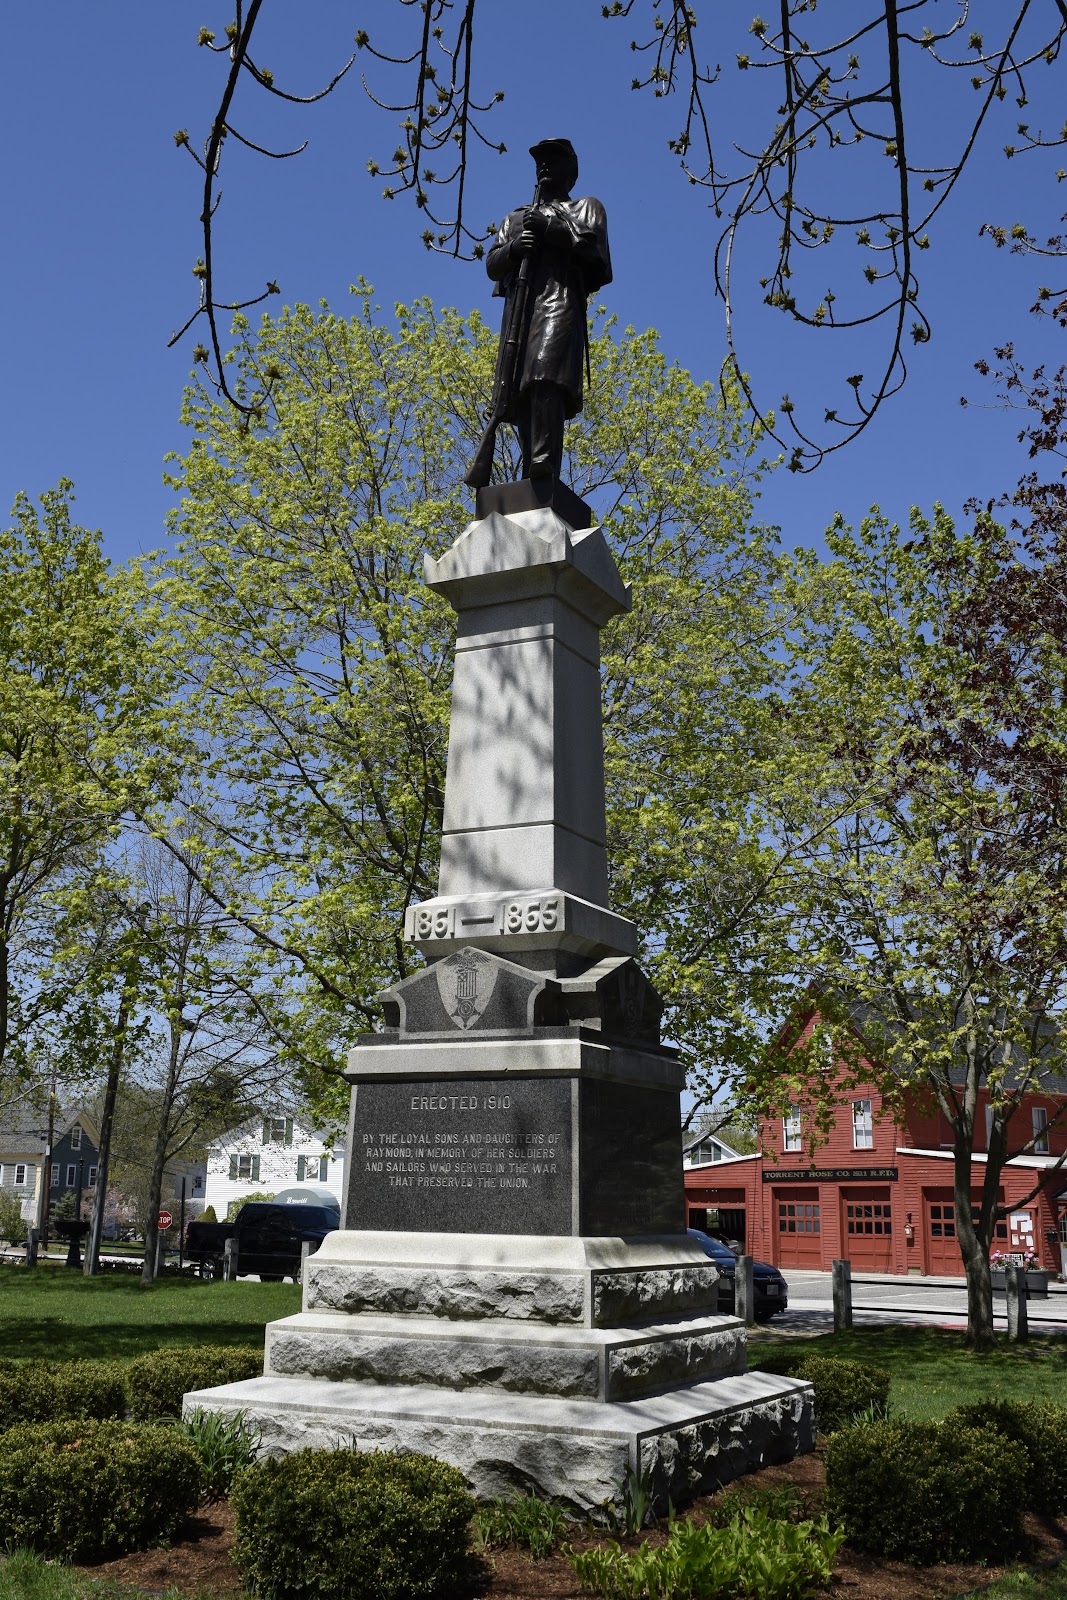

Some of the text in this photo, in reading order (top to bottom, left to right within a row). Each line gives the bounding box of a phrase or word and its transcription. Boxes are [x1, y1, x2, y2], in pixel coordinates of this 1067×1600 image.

[410, 908, 456, 941] 1861
[500, 901, 558, 935] 1865
[411, 1095, 511, 1110] ERECTED 1910
[362, 1133, 561, 1144] BY THE LOYAL SONS AND DAUGHTERS OF
[366, 1147, 555, 1158] RAYMOND, IN MEMORY OF HER SOLDIERS
[364, 1162, 383, 1172] AND
[386, 1162, 425, 1172] SAILORS
[454, 1162, 492, 1173] SERVED
[495, 1163, 505, 1173] IN
[508, 1163, 529, 1173] THE
[532, 1163, 557, 1174] WAR
[764, 1171, 806, 1179] TORRENT
[808, 1170, 834, 1178] HOSE
[389, 1176, 415, 1186] THAT
[417, 1176, 473, 1187] PRESERVED
[477, 1177, 496, 1187] THE
[159, 1216, 171, 1224] TOP
